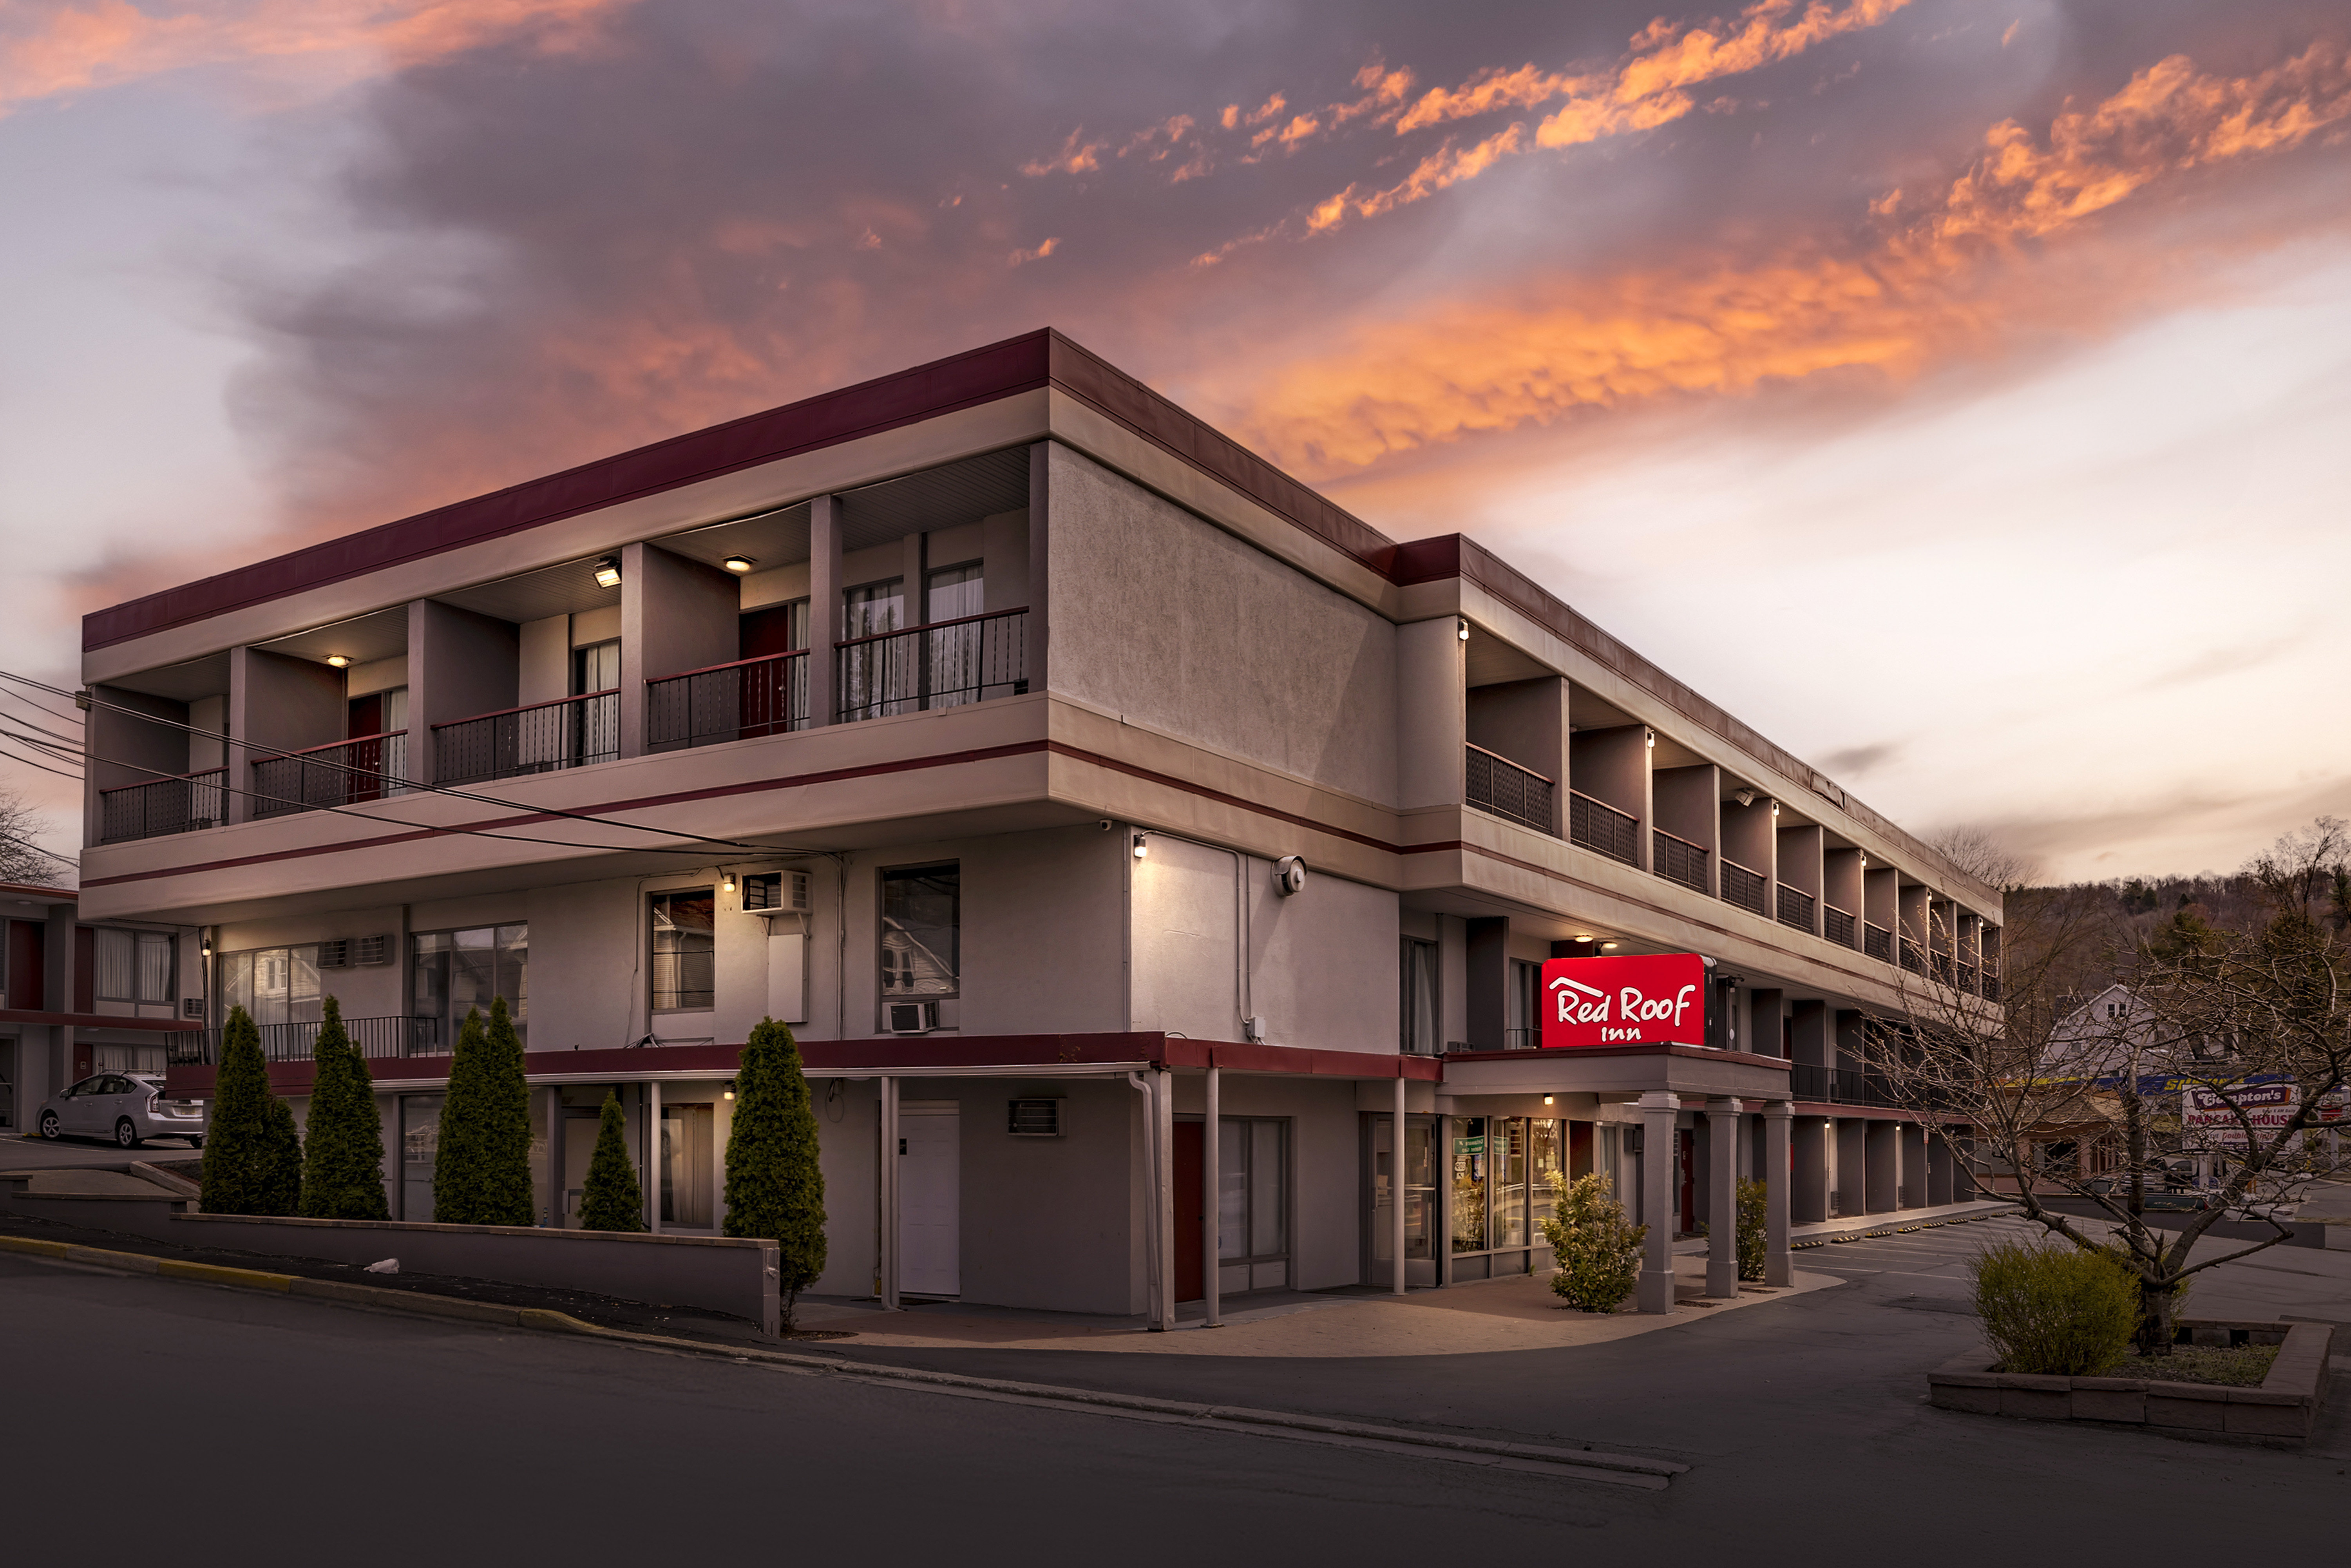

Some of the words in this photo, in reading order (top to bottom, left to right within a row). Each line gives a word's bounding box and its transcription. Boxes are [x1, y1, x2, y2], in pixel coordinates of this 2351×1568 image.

[1558, 990, 1611, 1025] Red
[1620, 985, 1696, 1027] Roof
[2252, 1115, 2295, 1125] HOUS
